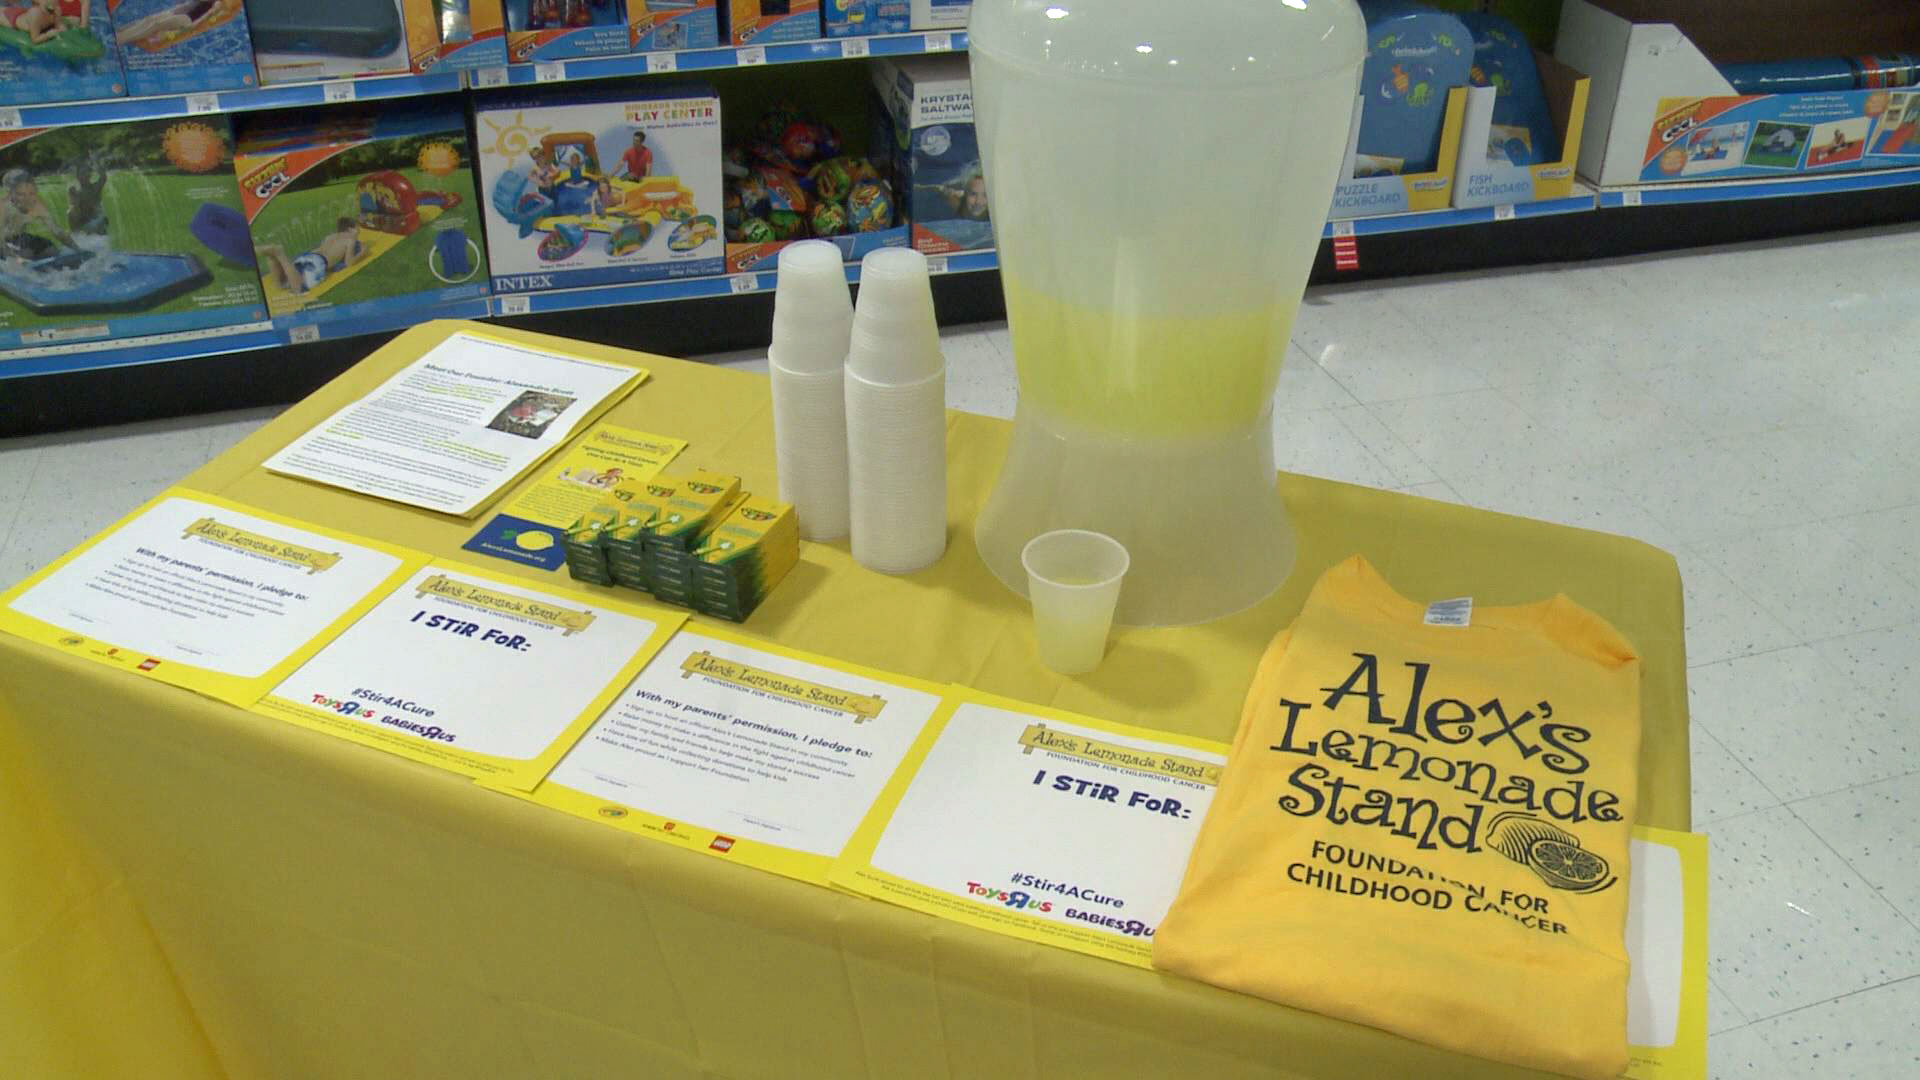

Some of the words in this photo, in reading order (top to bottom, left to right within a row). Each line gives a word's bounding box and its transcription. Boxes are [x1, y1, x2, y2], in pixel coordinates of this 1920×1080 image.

[626, 110, 658, 122] PLAY
[663, 107, 713, 120] CENTER
[921, 103, 973, 113] SALTWA
[1336, 183, 1378, 196] PUZZLE
[1467, 182, 1530, 198] KICKBOARD
[1469, 174, 1494, 186] FISH
[1335, 193, 1400, 208] KICKBOARD
[494, 274, 554, 291] INTEX
[410, 610, 426, 622] I
[351, 687, 435, 718] #Stir4ACure
[1319, 651, 1591, 775] Alex's
[636, 689, 662, 703] With
[664, 698, 682, 709] my
[682, 702, 733, 722] parents'
[732, 718, 798, 741] permission,
[802, 734, 809, 742] I
[809, 735, 852, 753] pledge
[855, 748, 873, 759] to:
[1046, 752, 1100, 769] FOUNDATION
[1102, 764, 1118, 773] FOR
[1120, 768, 1170, 783] CHILDHOOD
[1172, 778, 1206, 791] CANCER
[1270, 698, 1624, 824] Lemonade
[1033, 770, 1047, 785] I
[1278, 763, 1484, 854] Stand
[1011, 872, 1124, 909] #Stir4ACure
[1287, 862, 1453, 910] CHILDHOOD
[1499, 889, 1550, 915] FOR
